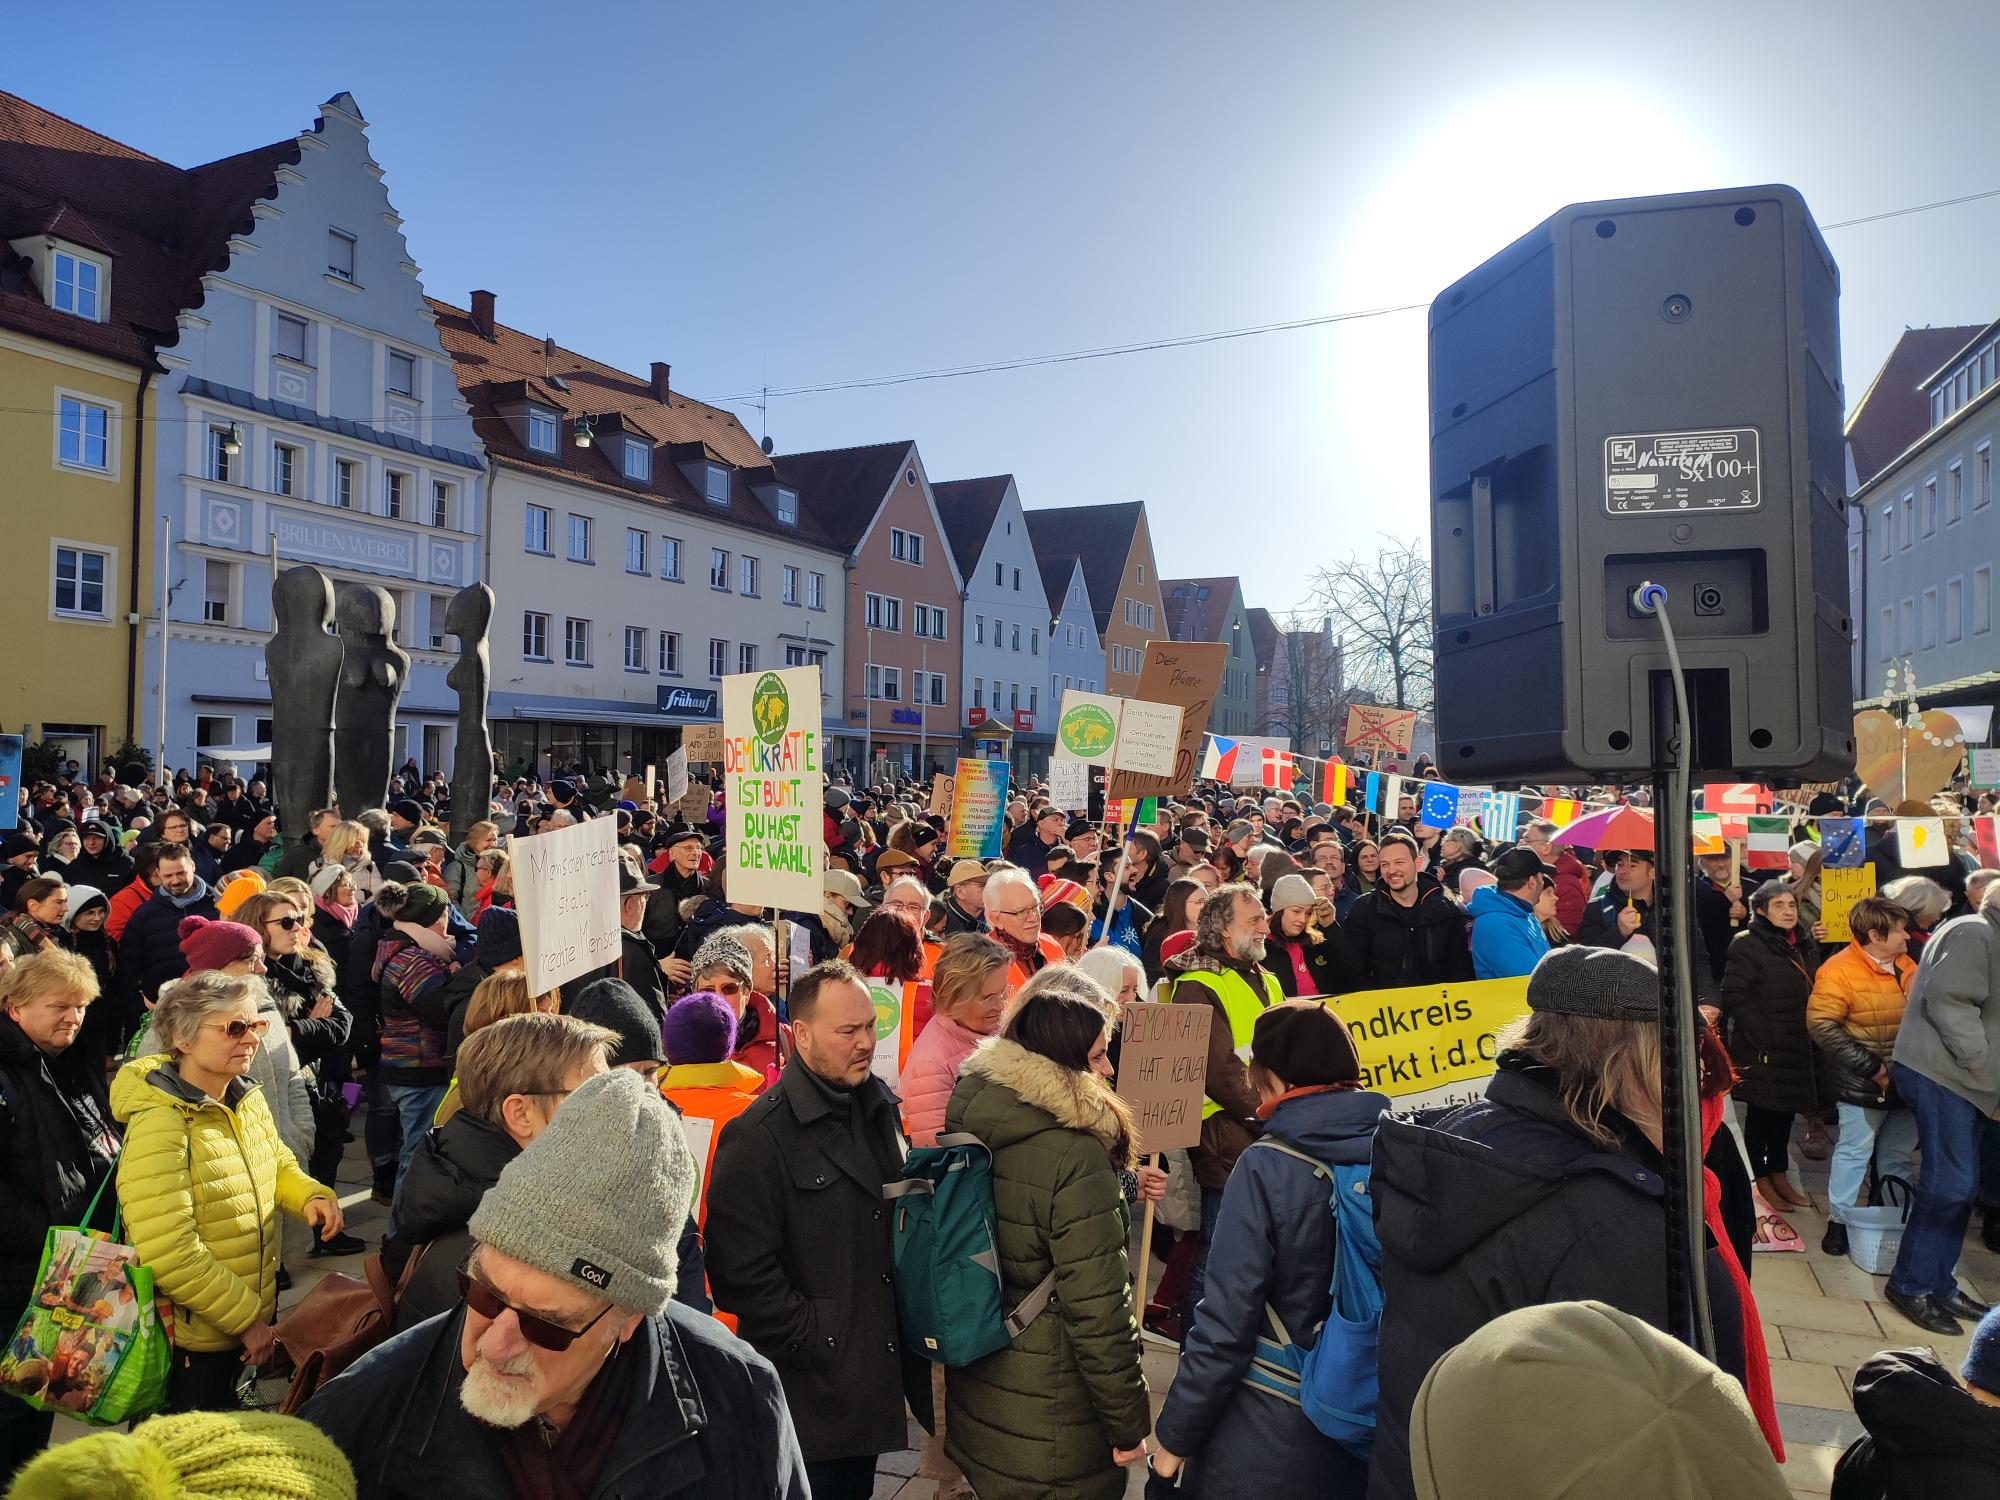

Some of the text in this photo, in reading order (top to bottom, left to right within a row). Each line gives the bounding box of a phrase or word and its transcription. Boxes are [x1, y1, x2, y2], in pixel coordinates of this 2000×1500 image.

[278, 522, 406, 563] BRILLEN WEBER
[661, 689, 716, 713] frühauf
[1127, 708, 1143, 717] Ganz
[689, 750, 724, 761] BILDUN
[725, 728, 817, 774] DEMOKRATIE
[1093, 775, 1111, 784] GEG
[744, 812, 801, 842] DU HAST
[530, 834, 618, 885] Menschenrechte
[765, 842, 813, 878] WAHL!
[557, 887, 592, 917] statt
[540, 935, 577, 976] rechte
[1123, 1006, 1211, 1044] DEMOKRATIE
[1347, 990, 1473, 1042] ndkreis
[1138, 1055, 1208, 1084] HAT KEINEN
[1359, 1033, 1497, 1089] arkt i.d.O
[1141, 1098, 1188, 1129] HAKEN
[581, 1265, 606, 1286] Cool
